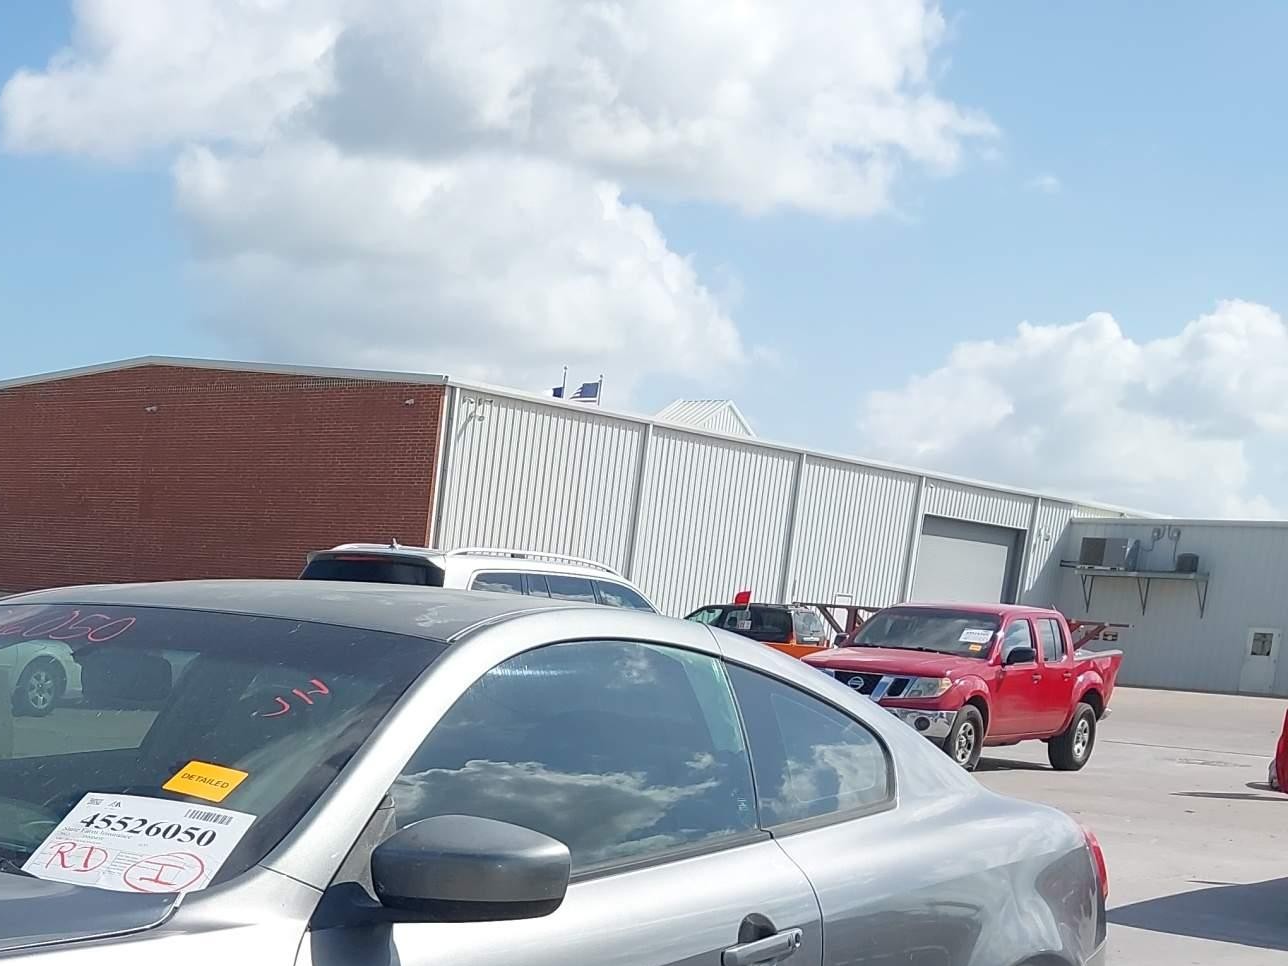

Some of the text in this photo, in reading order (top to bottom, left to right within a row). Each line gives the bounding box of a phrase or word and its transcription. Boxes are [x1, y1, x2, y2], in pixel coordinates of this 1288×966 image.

[181, 772, 230, 789] DETAILED
[80, 812, 217, 847] 45526050
[45, 841, 109, 872] RD
